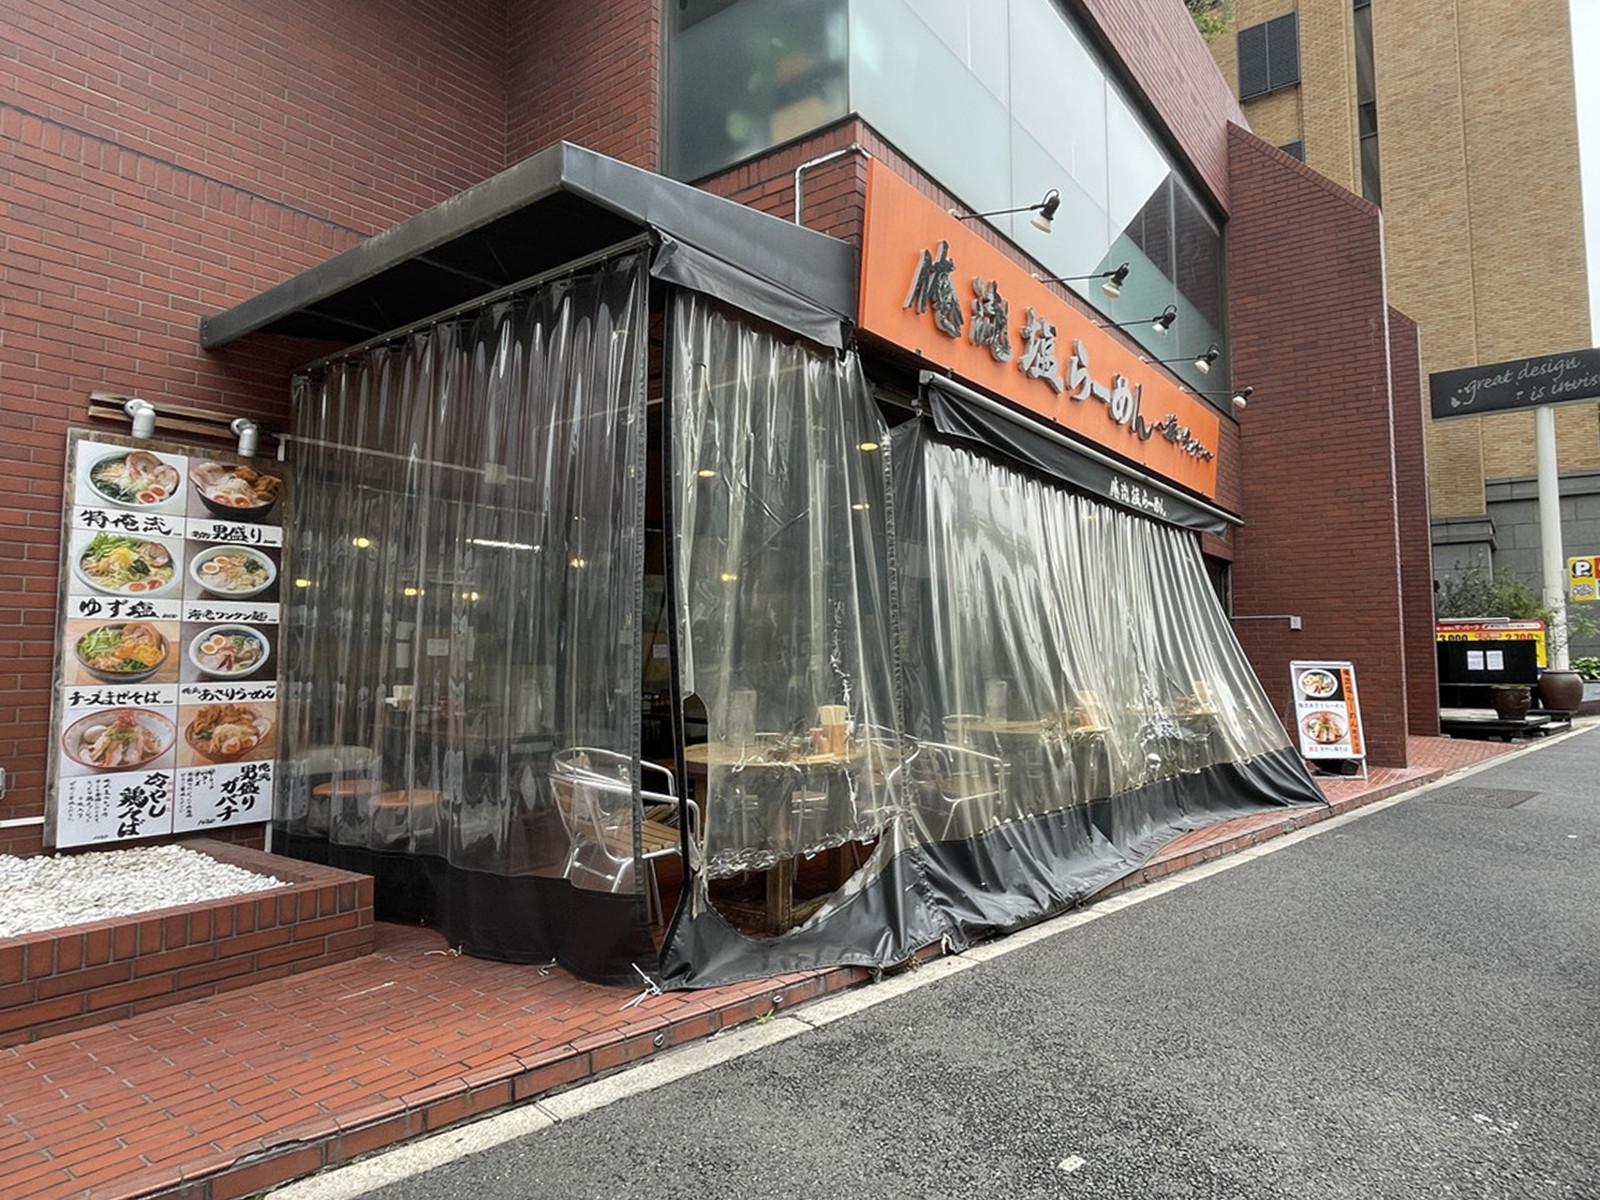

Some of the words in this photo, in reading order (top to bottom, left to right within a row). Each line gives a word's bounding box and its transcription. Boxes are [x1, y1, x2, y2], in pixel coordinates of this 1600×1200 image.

[1463, 370, 1514, 405] great
[1518, 357, 1581, 382] design
[1530, 386, 1546, 401] is
[1551, 371, 1600, 395] invis
[79, 597, 160, 619] ゆず塩
[68, 690, 161, 706] チーズまぜそば
[144, 772, 170, 818] 冷やし
[237, 764, 260, 811] 男盛り
[116, 785, 149, 838] 鶏そば
